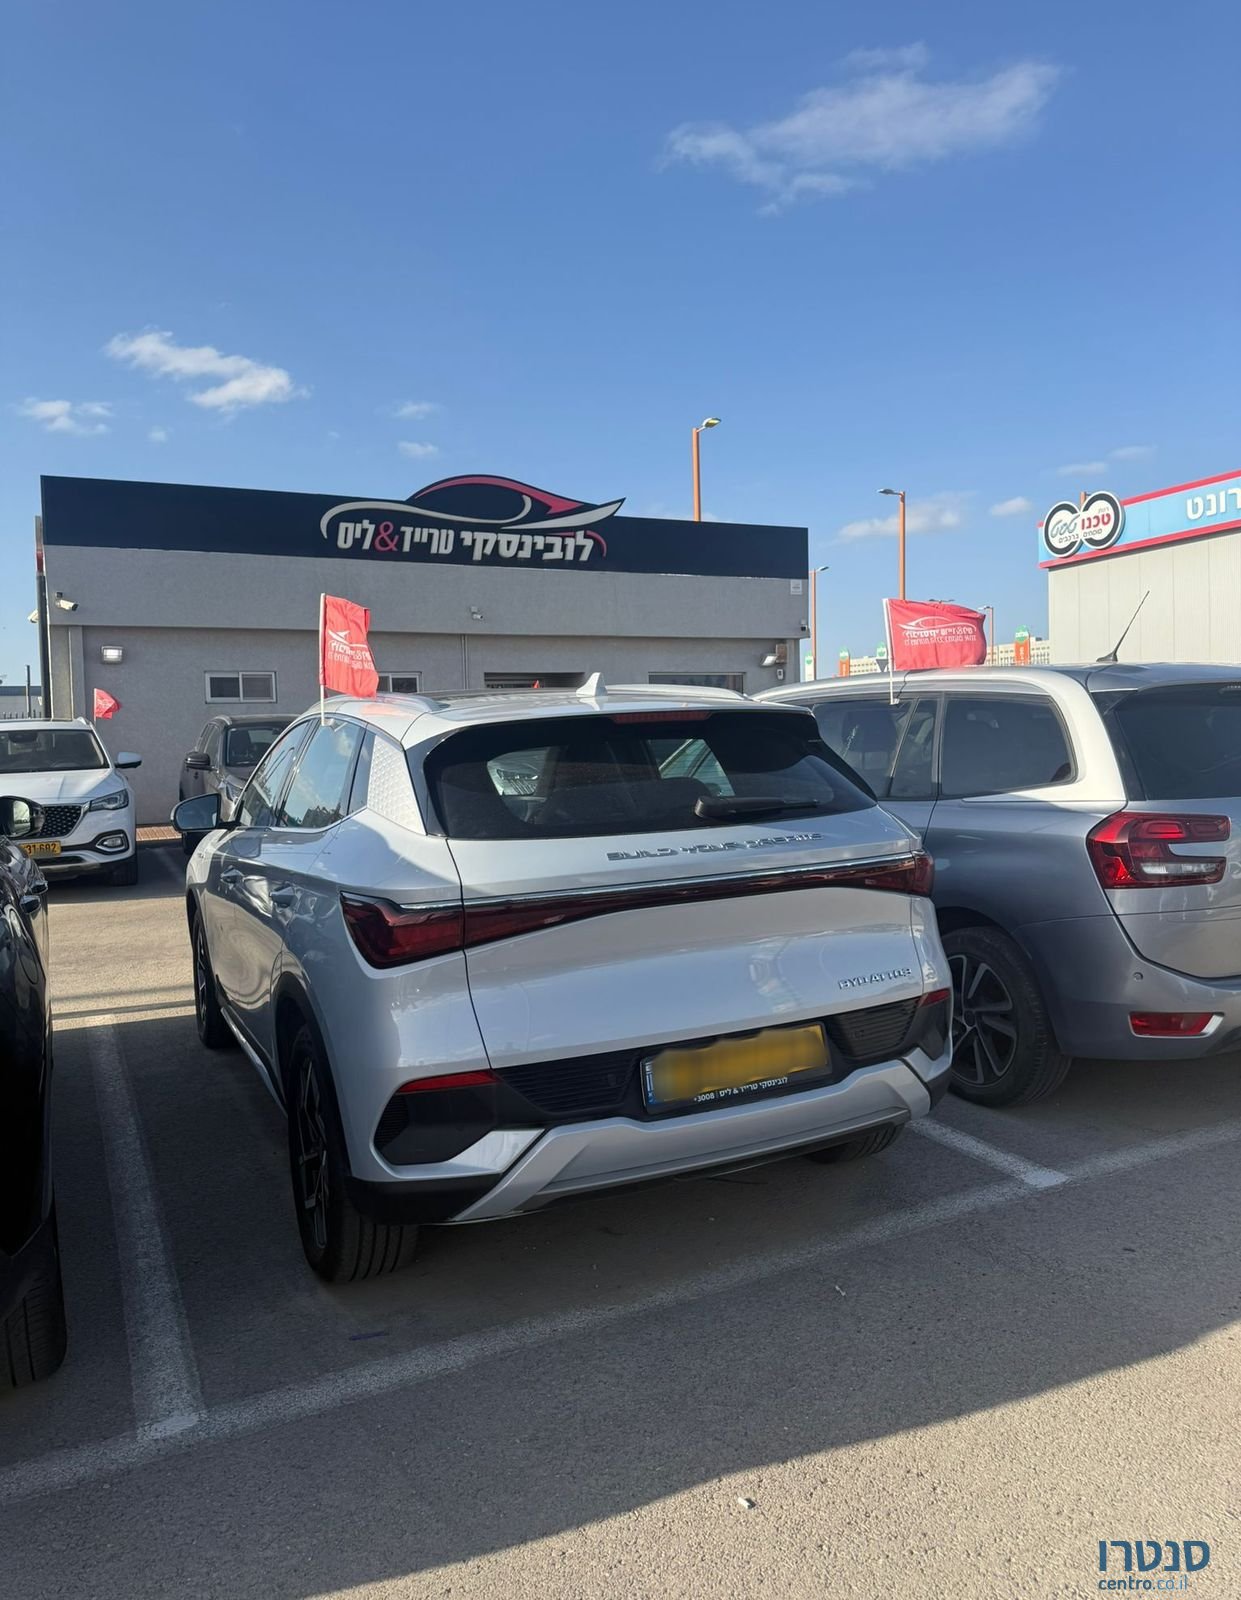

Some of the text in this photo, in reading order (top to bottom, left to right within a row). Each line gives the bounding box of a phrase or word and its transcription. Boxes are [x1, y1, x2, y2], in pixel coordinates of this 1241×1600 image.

[1081, 513, 1112, 531] טכנו
[460, 530, 594, 561] לובינסקי
[607, 832, 824, 861] BUILD YOUR DREAMS
[759, 1076, 788, 1089] לובינסקי
[719, 1088, 732, 1097] ליס
